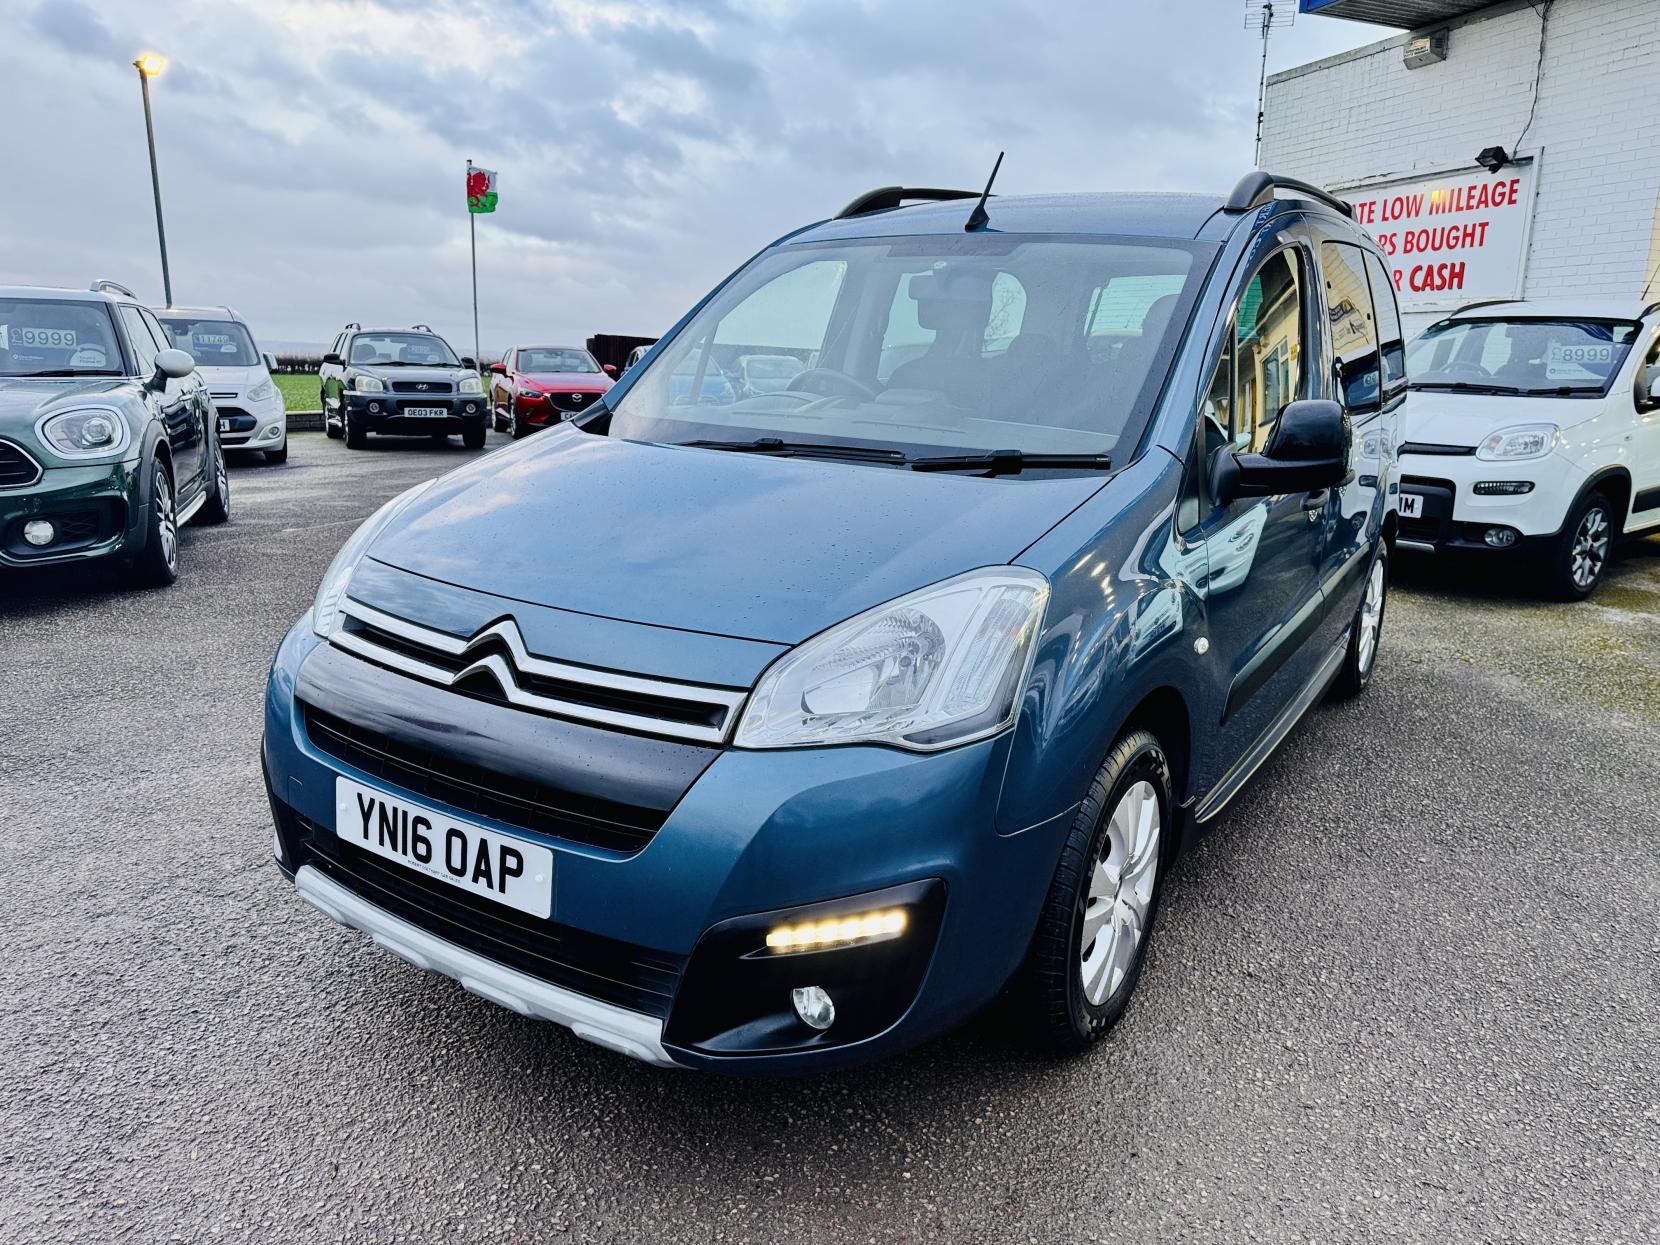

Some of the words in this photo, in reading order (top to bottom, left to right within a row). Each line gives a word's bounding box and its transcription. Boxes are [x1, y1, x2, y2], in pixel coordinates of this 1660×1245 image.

[1381, 193, 1425, 222] LOW
[1428, 178, 1520, 216] MILEAGE
[1403, 221, 1489, 255] BOUGHT
[1409, 261, 1466, 292] CASH
[356, 792, 433, 865] YN16
[445, 827, 524, 894] OAP
